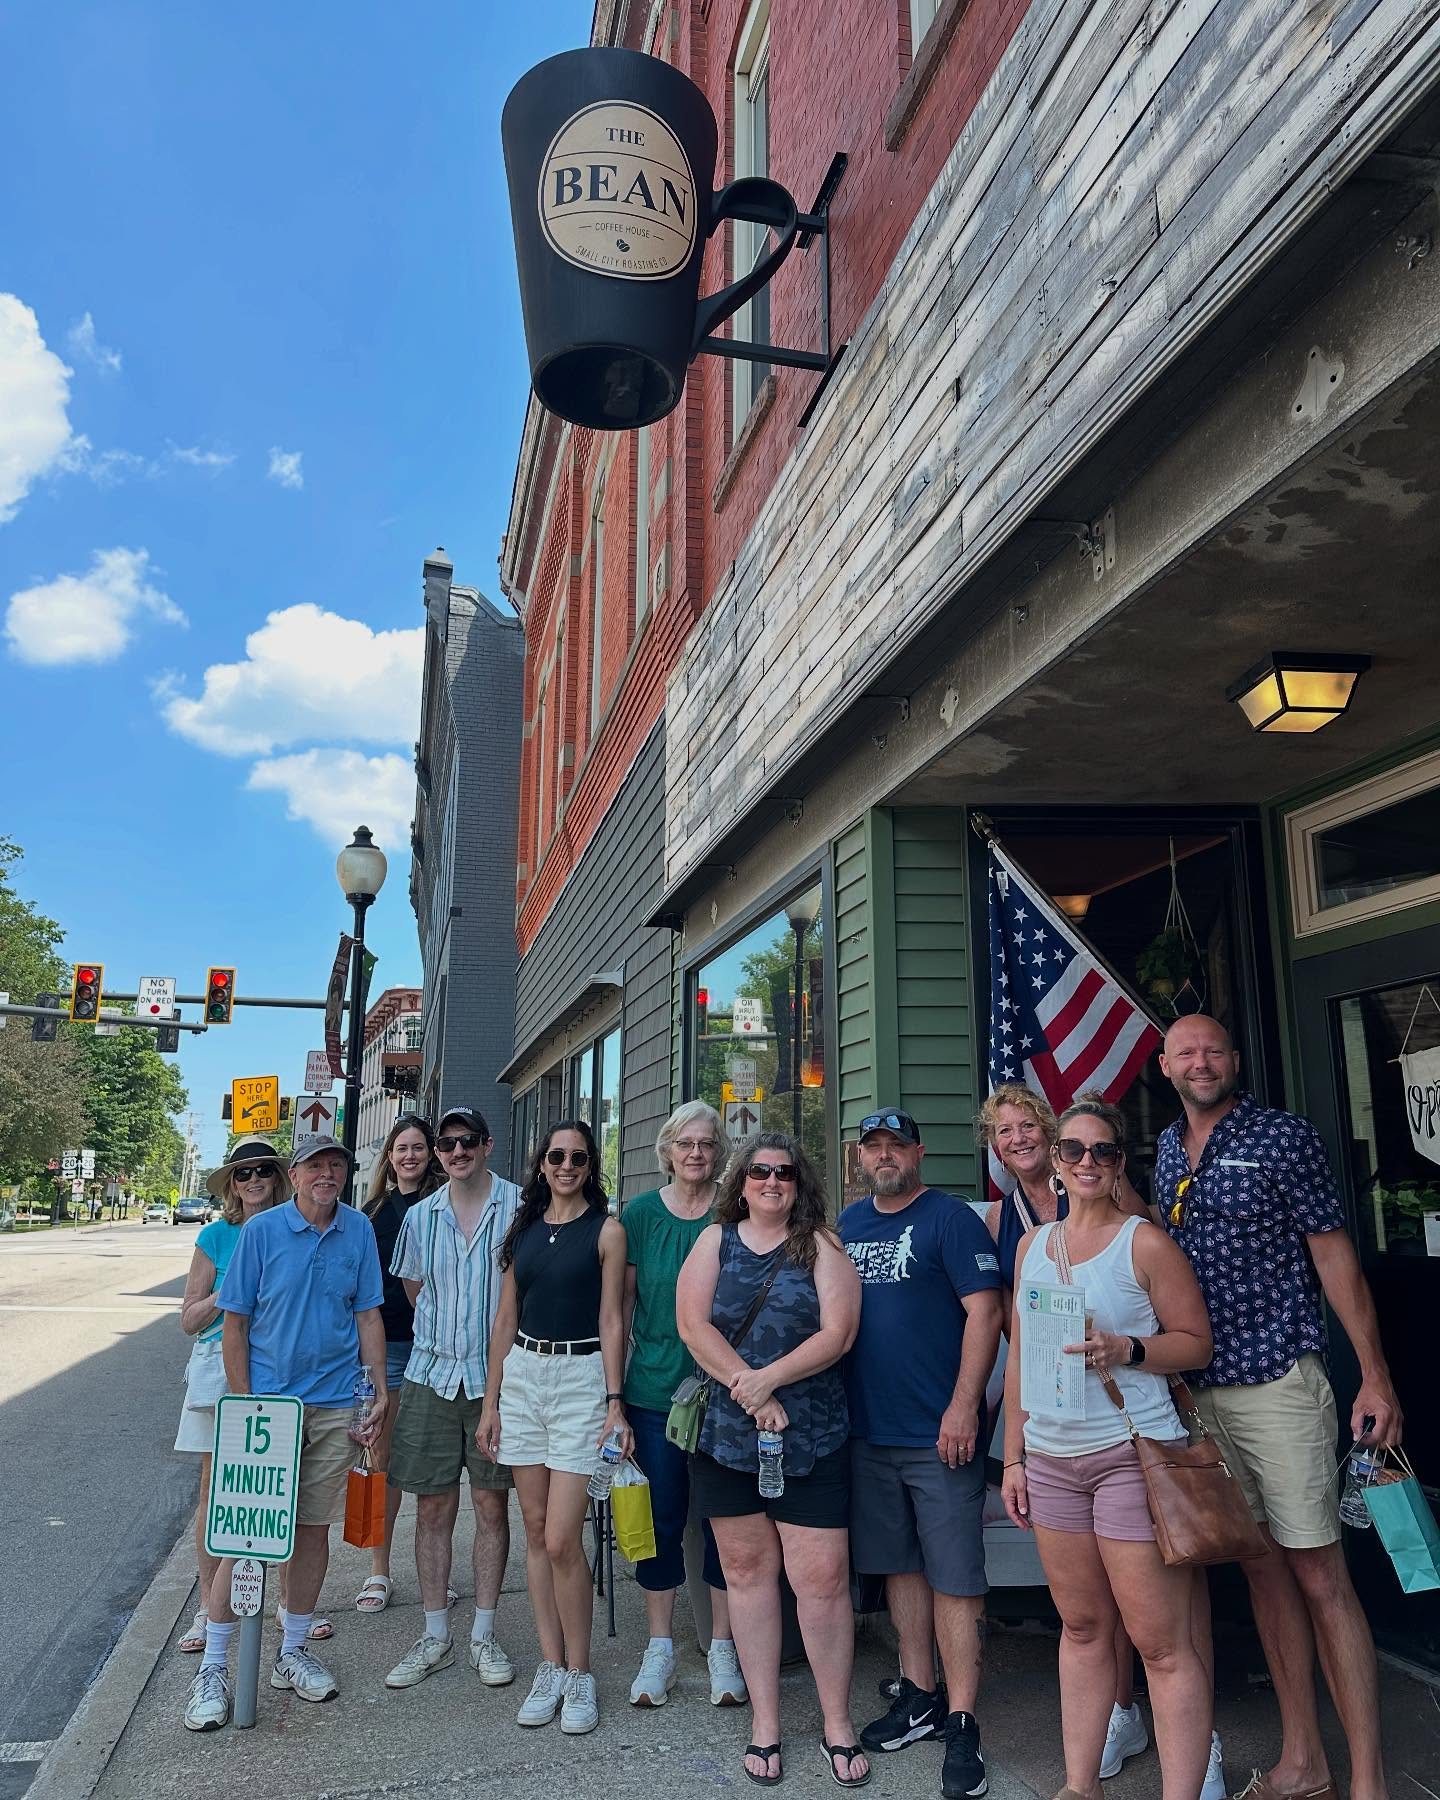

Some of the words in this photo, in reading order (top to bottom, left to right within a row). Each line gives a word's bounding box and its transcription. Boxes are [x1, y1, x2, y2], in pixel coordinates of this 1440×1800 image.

[605, 127, 646, 147] THE
[551, 164, 689, 226] BEAN
[594, 222, 623, 232] COFFEE
[625, 225, 650, 238] HOUSE
[575, 245, 599, 262] SMALL
[601, 255, 620, 267] CITY
[622, 260, 658, 270] ROASTING
[150, 979, 165, 987] NO
[140, 996, 151, 1004] ON
[316, 1054, 326, 1063] NO
[239, 1082, 272, 1095] STOP
[252, 1117, 273, 1128] RED
[64, 1159, 75, 1168] 20
[245, 1415, 271, 1455] 15
[221, 1463, 287, 1497] MINUTE
[213, 1504, 288, 1541] PARKING
[242, 1565, 254, 1573] NO
[233, 1573, 262, 1583] PARKING
[241, 1593, 252, 1601] TO
[247, 1603, 258, 1611] AM
